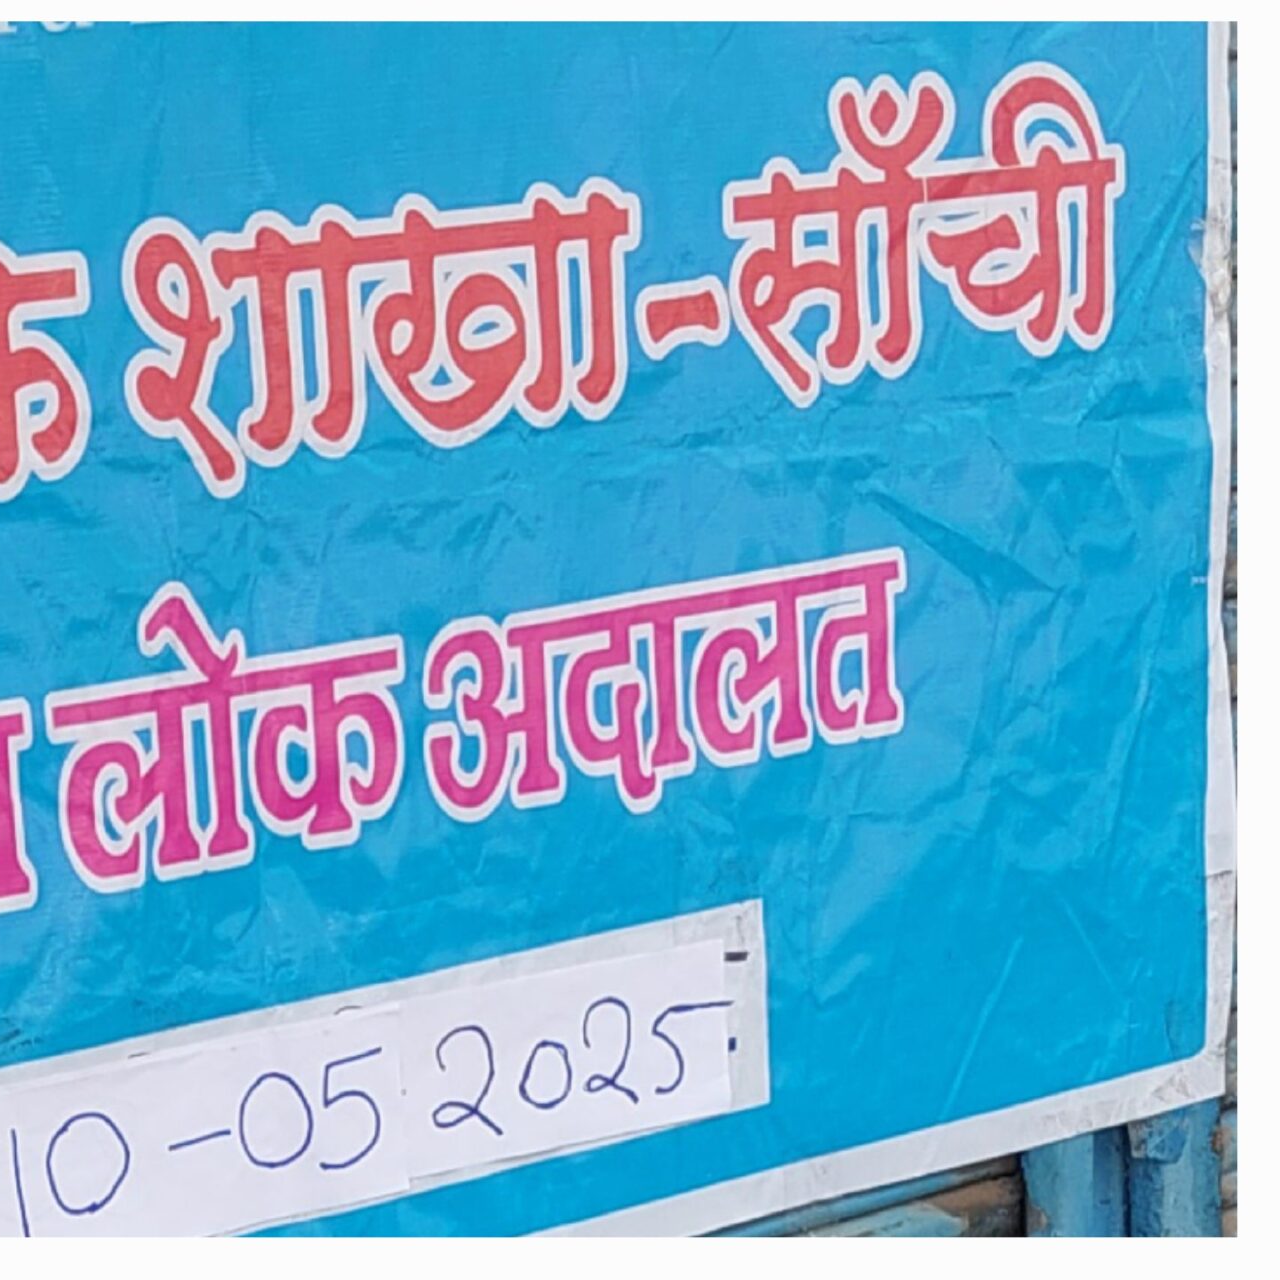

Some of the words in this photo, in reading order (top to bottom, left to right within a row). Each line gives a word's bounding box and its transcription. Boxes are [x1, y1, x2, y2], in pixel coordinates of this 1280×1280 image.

[47, 587, 401, 887] लोक
[425, 553, 904, 816] अदालत
[429, 995, 736, 1138] 2025
